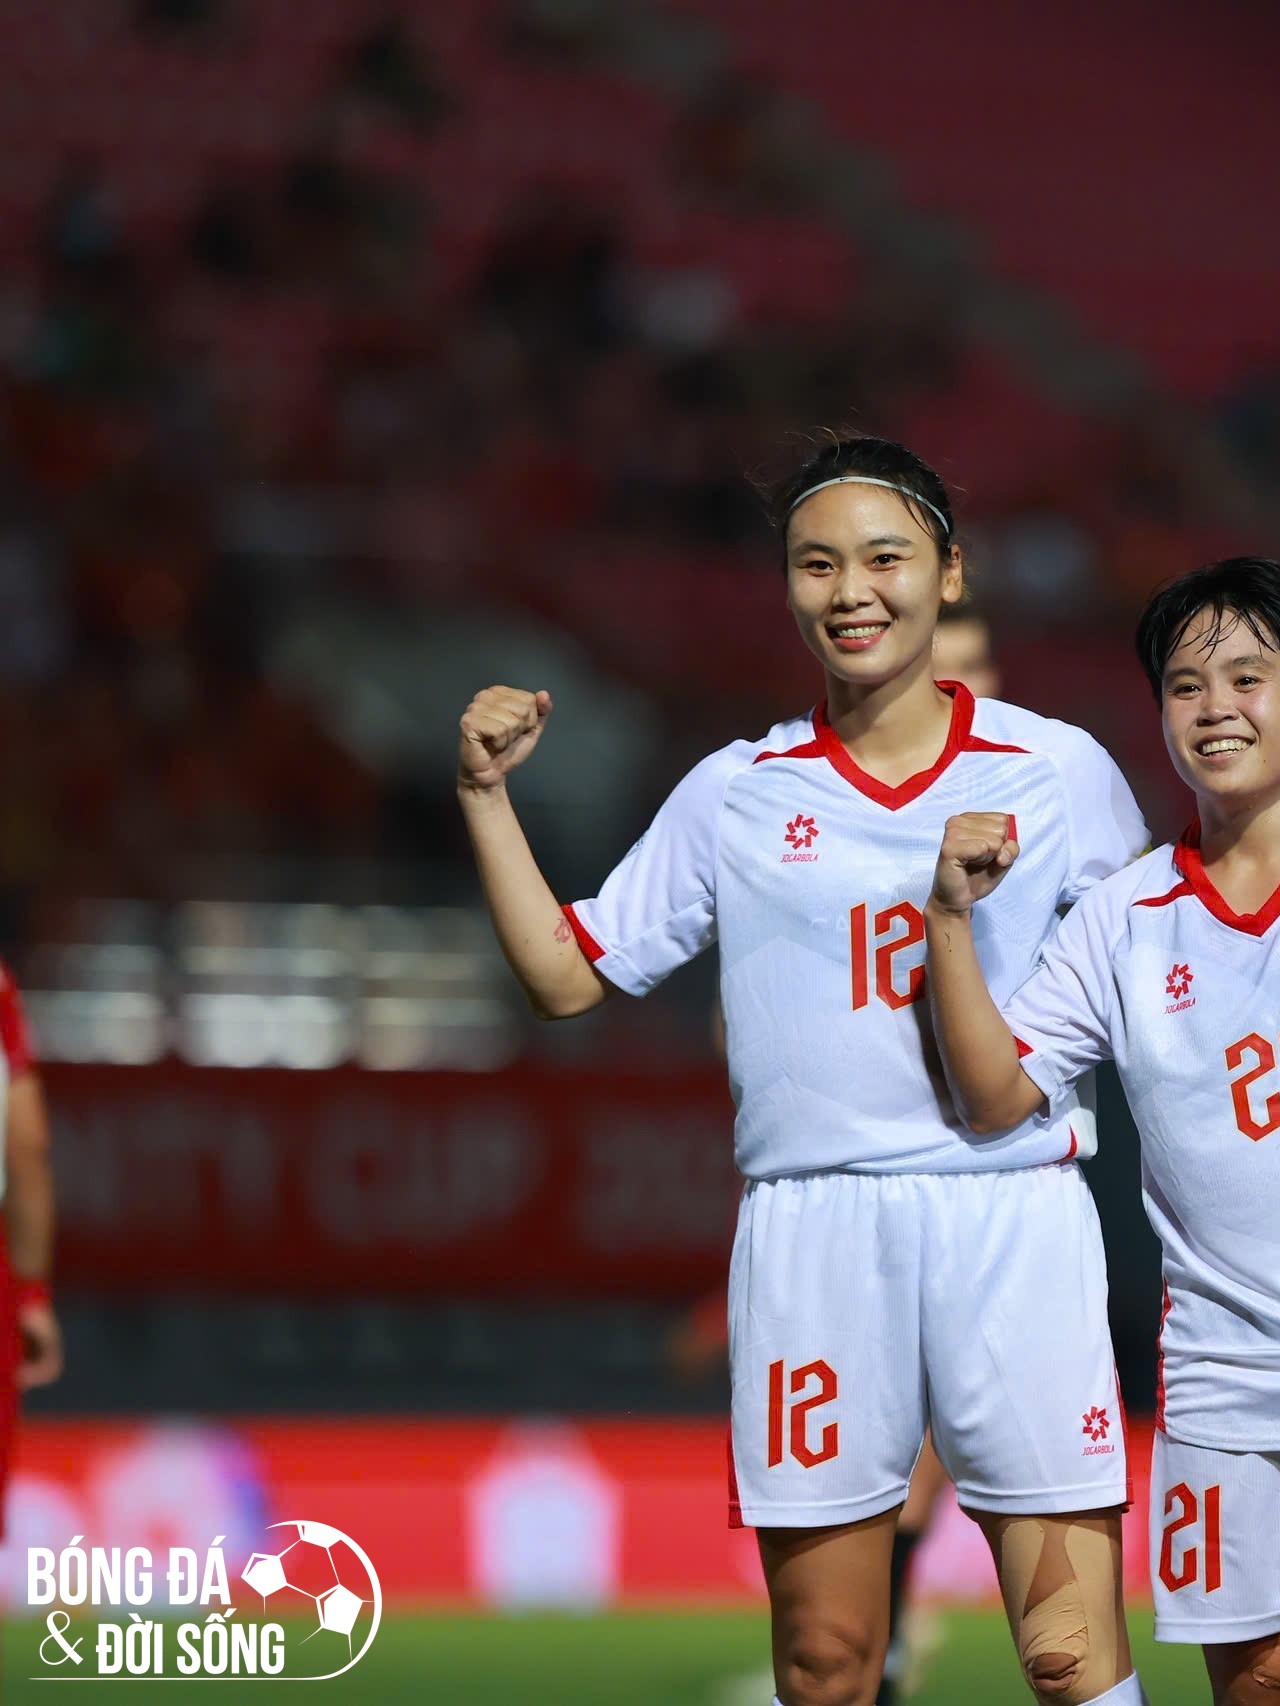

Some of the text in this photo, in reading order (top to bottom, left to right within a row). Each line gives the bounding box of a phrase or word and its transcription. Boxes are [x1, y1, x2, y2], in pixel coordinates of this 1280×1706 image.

[781, 853, 819, 863] JOGARBOLA
[849, 900, 926, 1011] 12
[1164, 997, 1196, 1014] JOGARBOLA
[768, 1359, 839, 1469] 12
[1082, 1444, 1115, 1456] JOGARBOLA
[1158, 1481, 1222, 1593] 21
